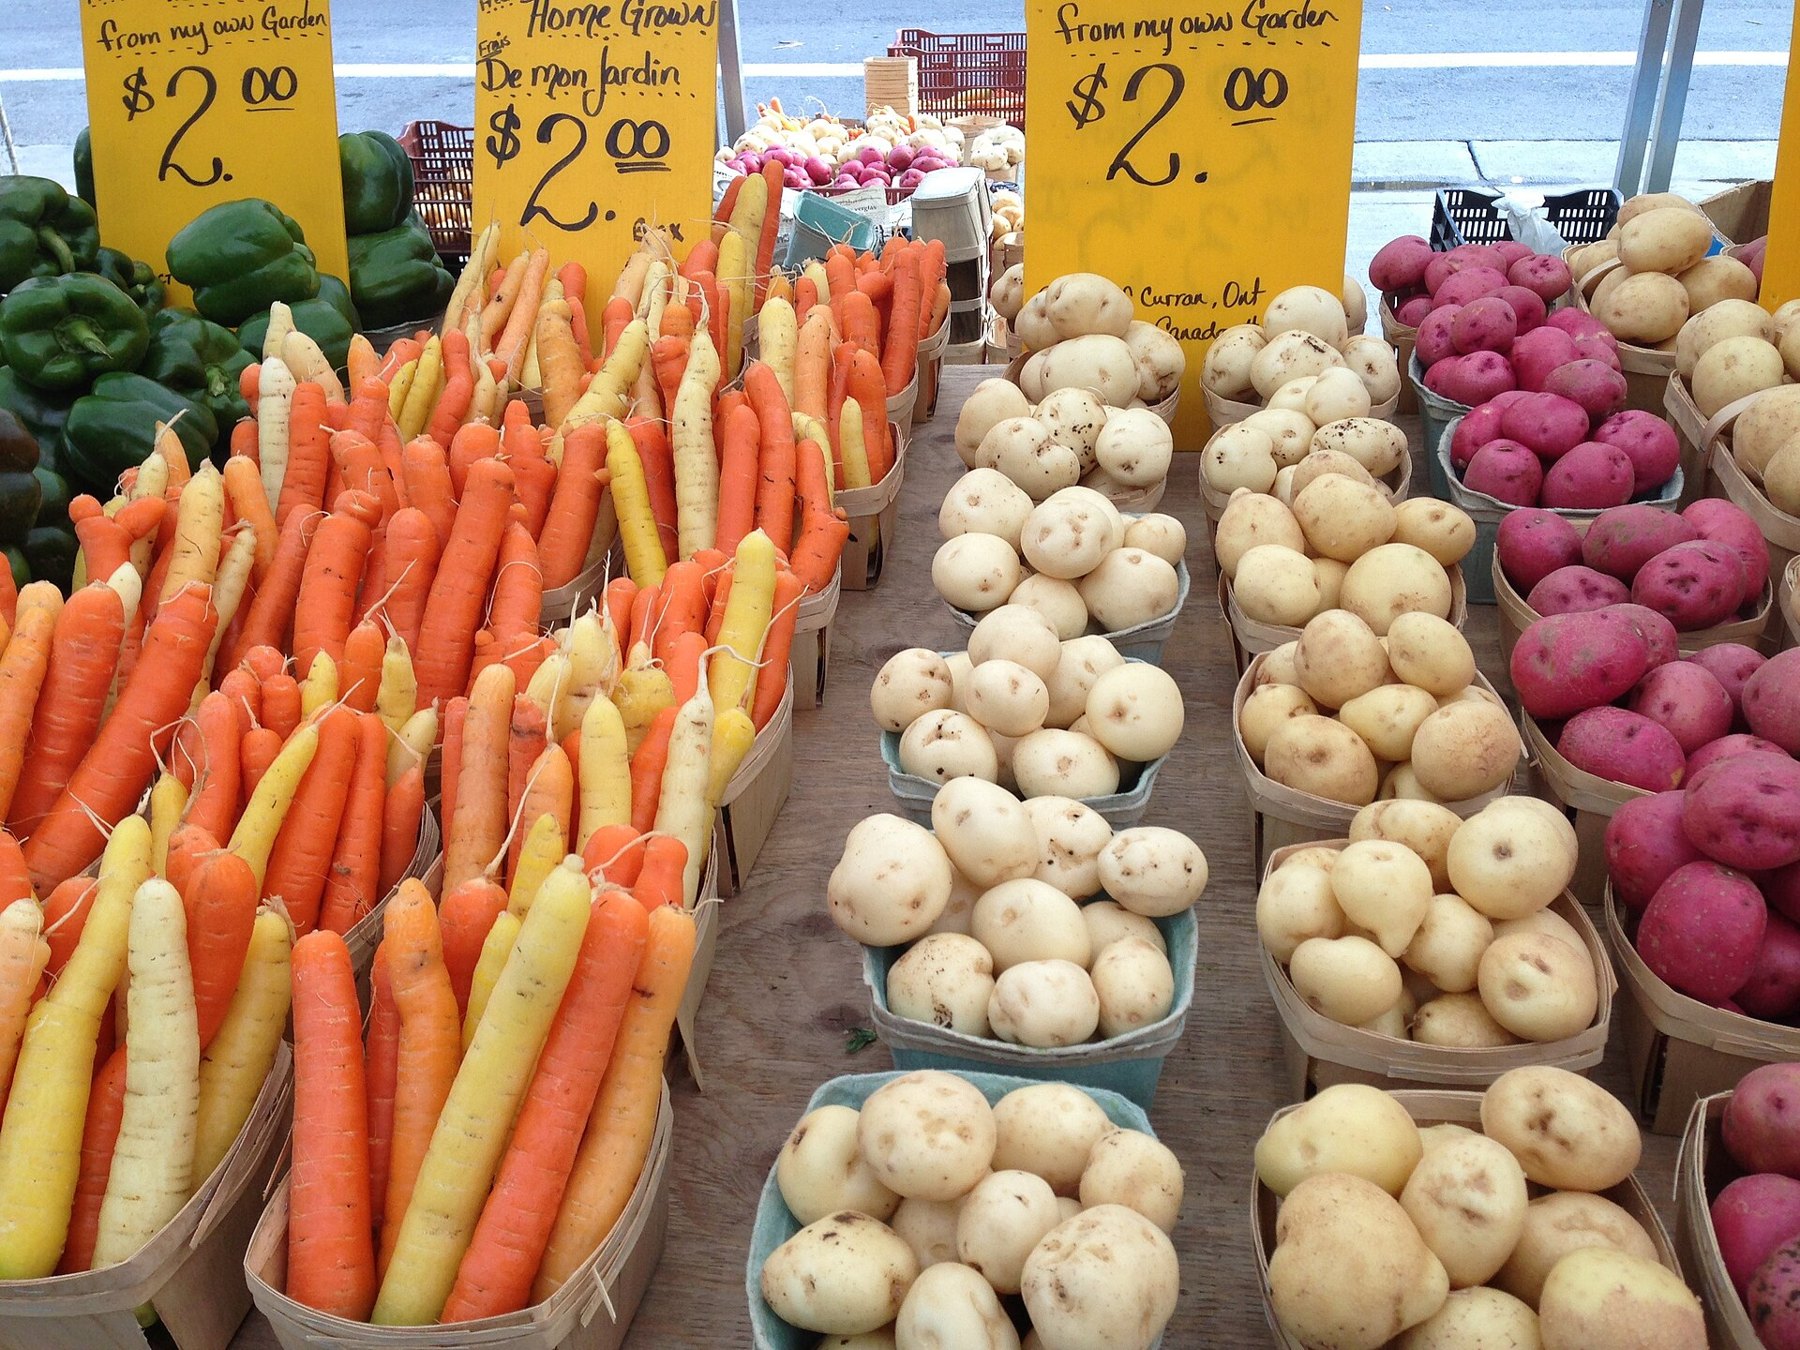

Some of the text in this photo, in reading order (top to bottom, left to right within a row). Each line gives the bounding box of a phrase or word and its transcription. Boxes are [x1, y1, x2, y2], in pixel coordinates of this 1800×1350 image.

[97, 0, 327, 55] from my own Garden
[526, 0, 612, 38] Home
[1055, 0, 1339, 56] from my own Garden
[478, 31, 511, 56] Frais
[476, 58, 522, 92] De
[531, 63, 588, 99] mon
[1222, 277, 1267, 308] Ont
